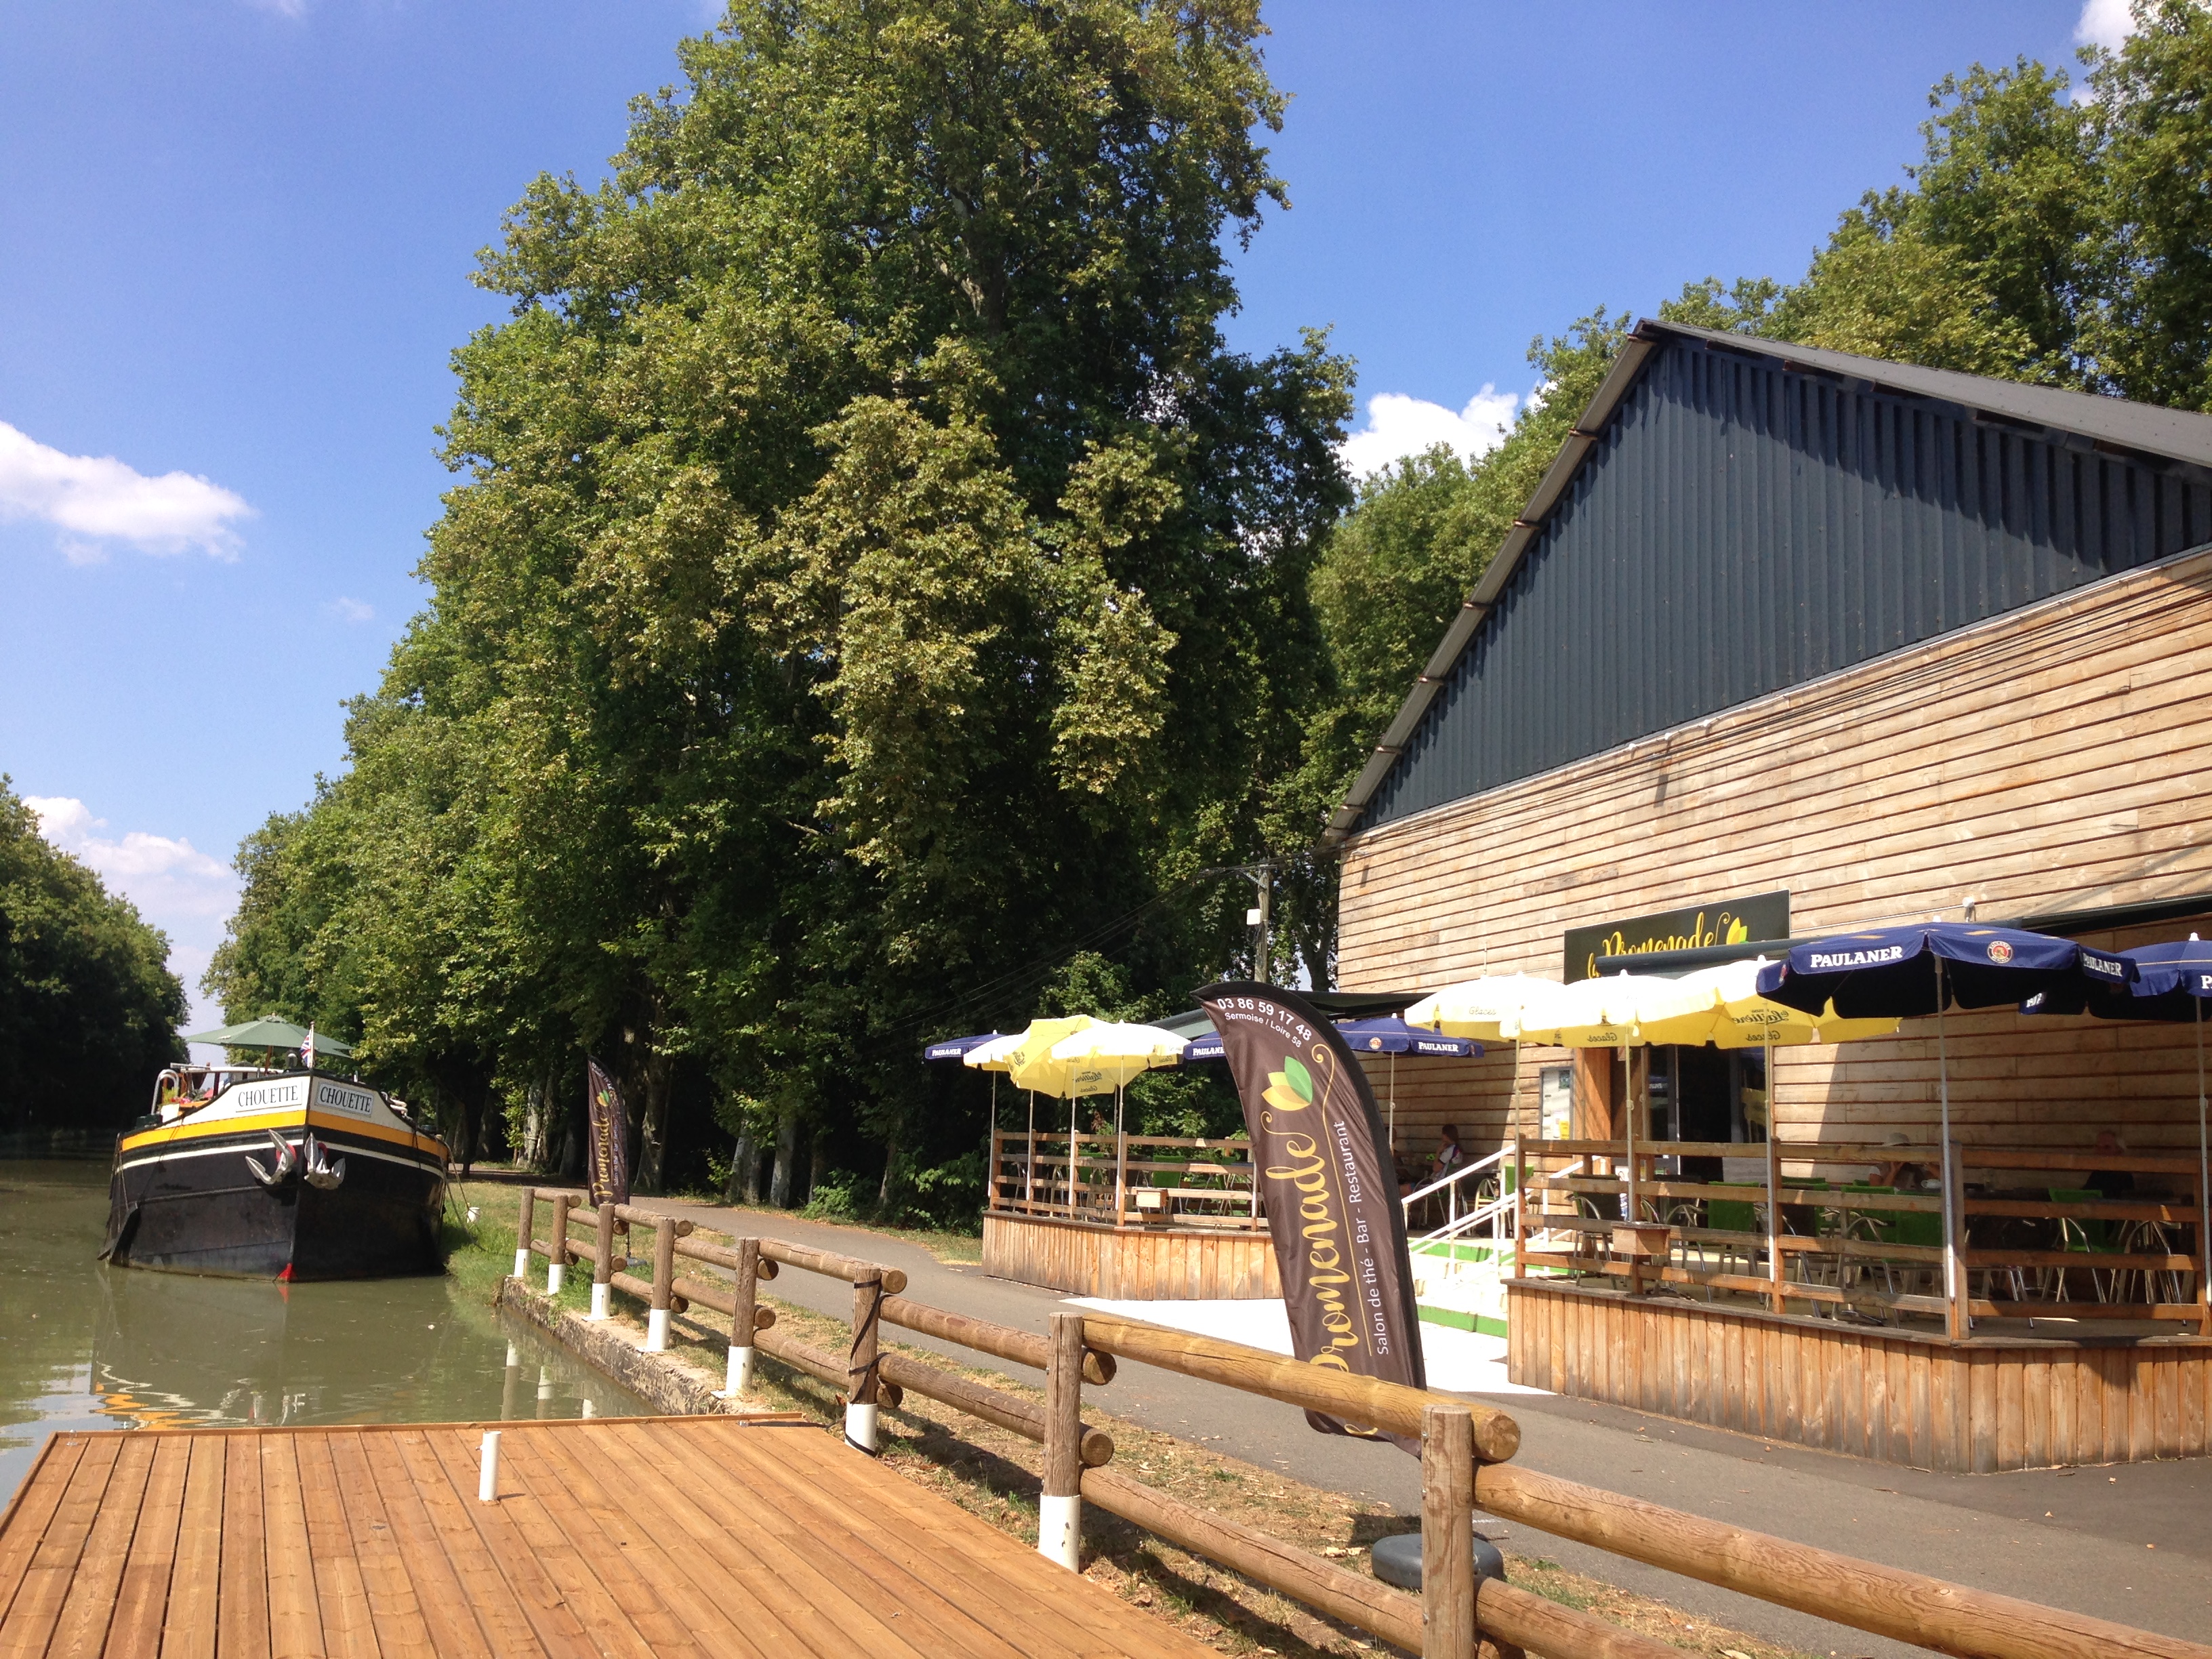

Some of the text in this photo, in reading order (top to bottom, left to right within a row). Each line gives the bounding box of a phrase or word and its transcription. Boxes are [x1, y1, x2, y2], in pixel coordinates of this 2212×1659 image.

[1810, 946, 1902, 968] PAULANER
[2083, 952, 2123, 977] PAULANER
[1217, 998, 1312, 1041] 03 86 59 17 48
[1469, 1006, 1496, 1015] Glaces
[1224, 1012, 1264, 1024] Sermoise
[1270, 1021, 1290, 1038] Loire
[1292, 1036, 1302, 1048] 58
[932, 1048, 962, 1057] PAULANER
[1418, 1042, 1459, 1052] PAULANER
[238, 1085, 298, 1107] CHOUETTE
[320, 1086, 372, 1113] CHOUETTE
[1333, 1120, 1362, 1203] Restaurant
[1356, 1218, 1369, 1243] Bar
[1360, 1258, 1377, 1284] thé
[1368, 1288, 1381, 1307] de
[1374, 1312, 1389, 1355] Salon
